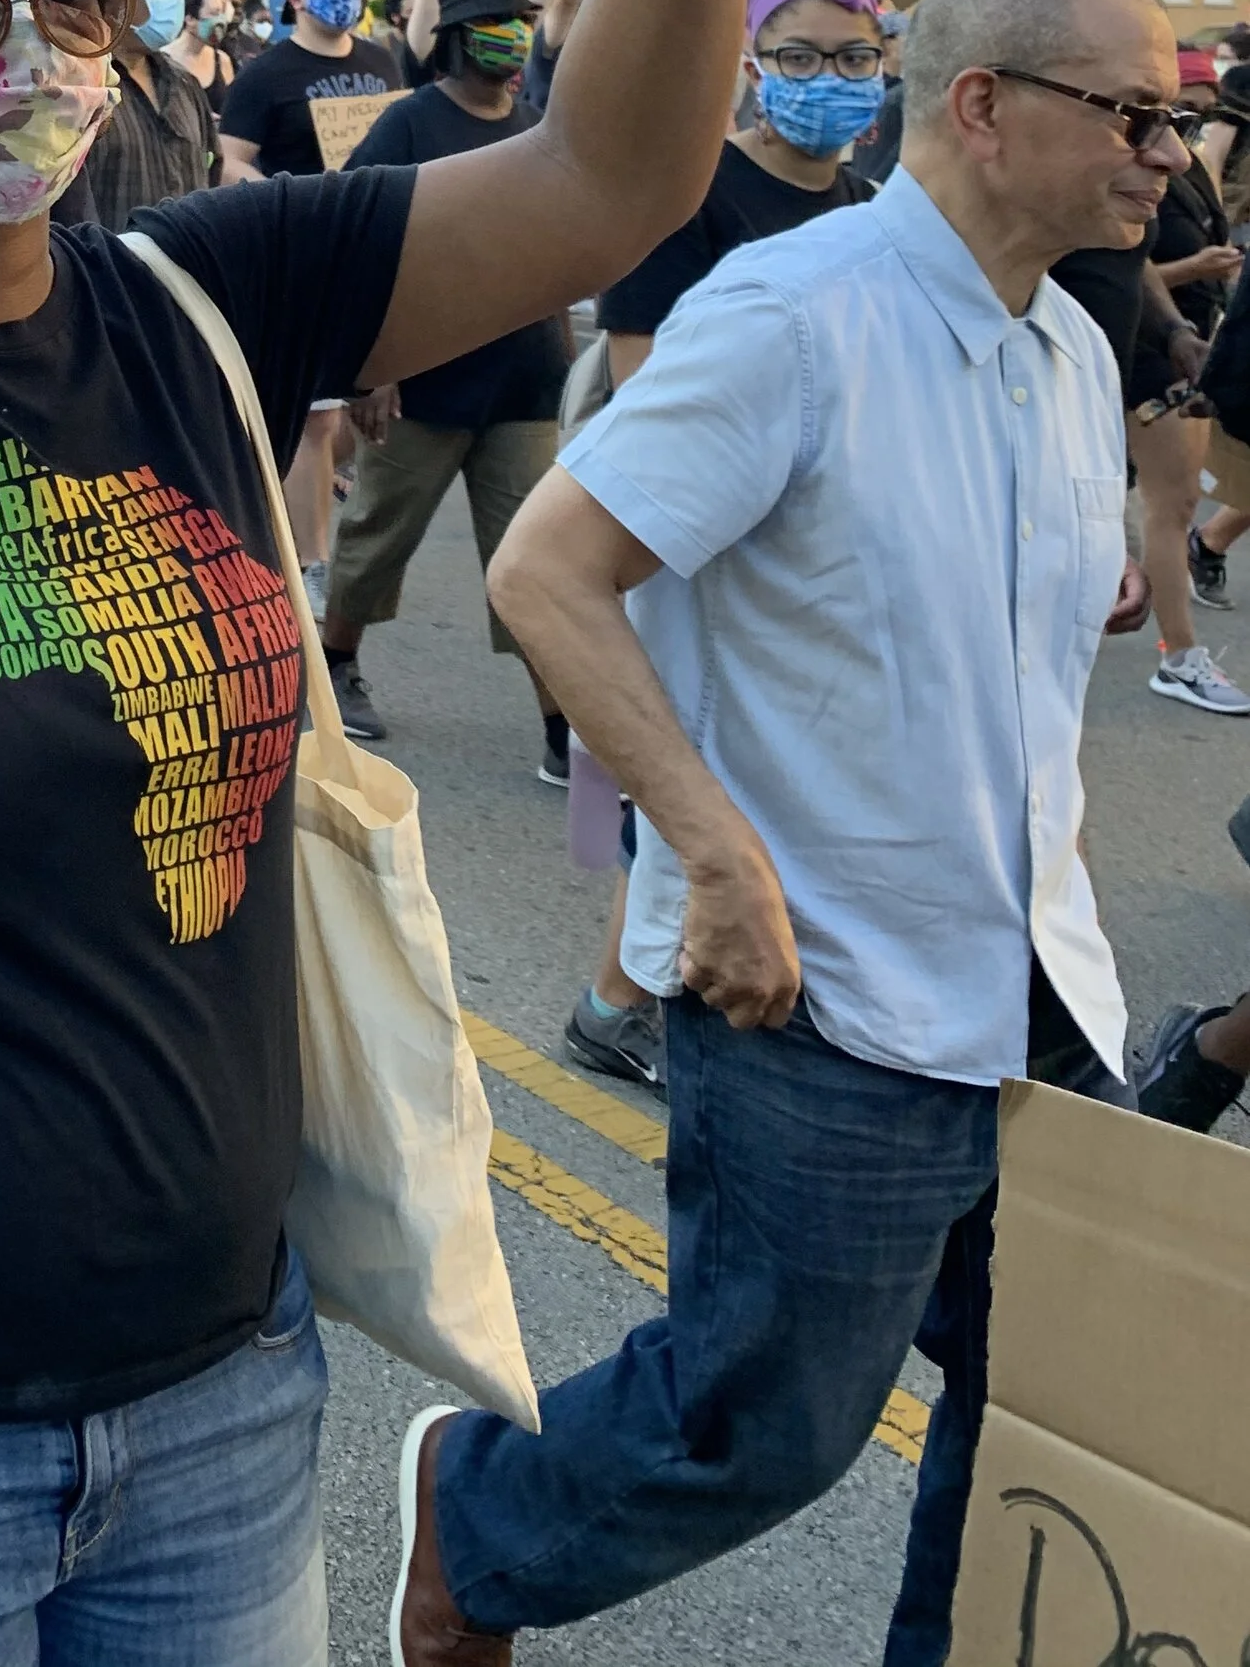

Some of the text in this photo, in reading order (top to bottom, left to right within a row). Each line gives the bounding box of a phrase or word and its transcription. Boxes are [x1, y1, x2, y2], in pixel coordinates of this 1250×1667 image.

[306, 73, 386, 98] CHICAGO
[121, 508, 243, 560] SENEGA
[14, 555, 191, 607] UGANDA
[32, 582, 204, 639] SOMALIA
[82, 594, 300, 692] SOUTH AFRIC
[111, 674, 216, 722] ZIMBABWE
[127, 704, 220, 763] MALI
[147, 751, 219, 793] ERRA
[142, 808, 263, 871] MOROCCO
[155, 849, 247, 944] ETHIOPIA
